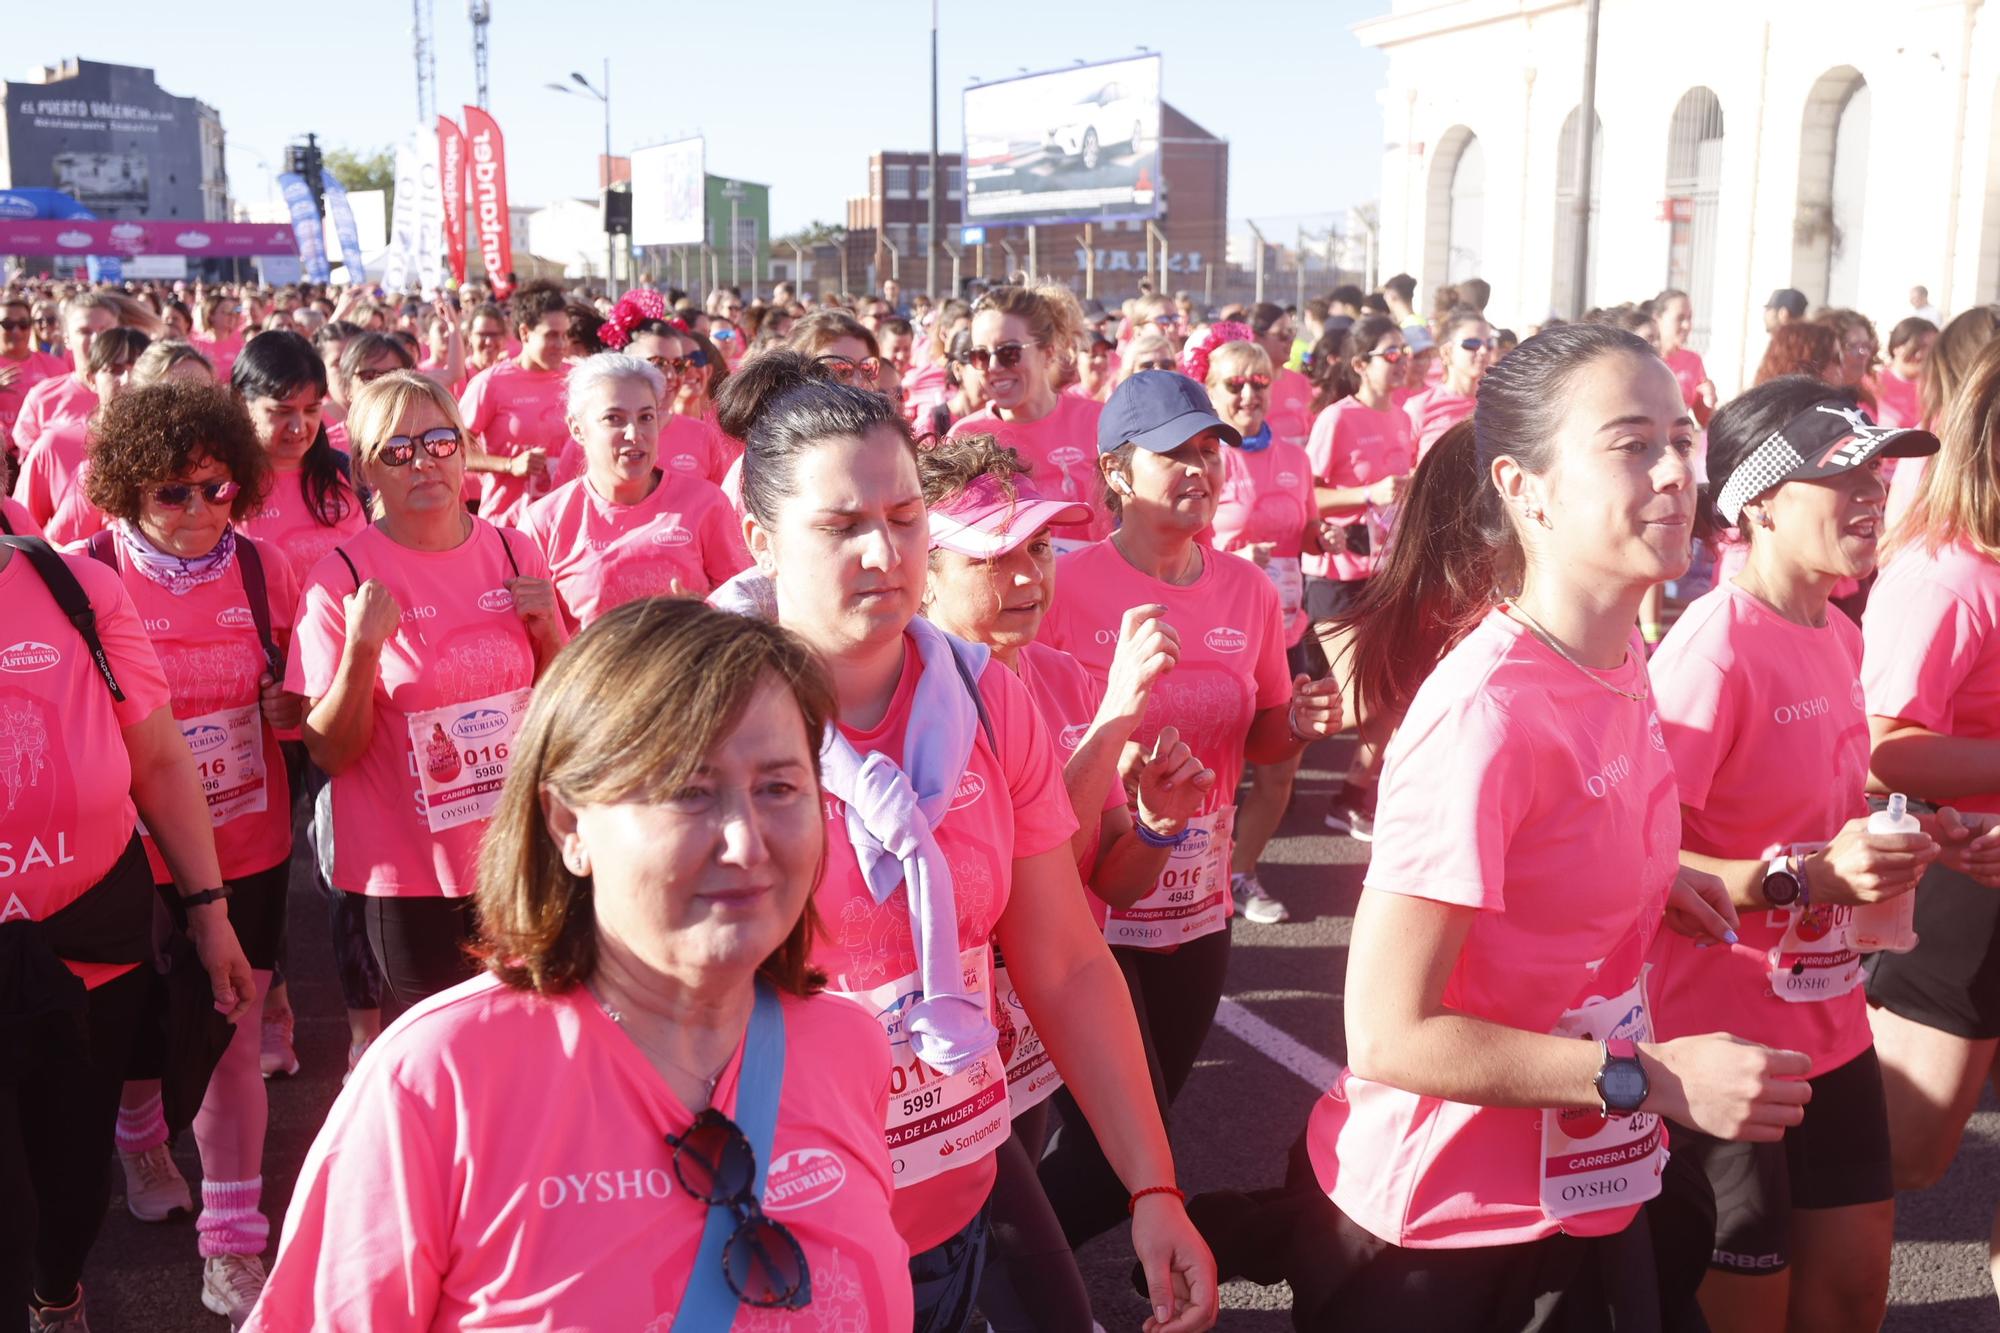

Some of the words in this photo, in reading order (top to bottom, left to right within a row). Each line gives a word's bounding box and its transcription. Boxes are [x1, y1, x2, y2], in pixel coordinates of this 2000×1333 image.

[37, 100, 88, 117] PUERTO
[400, 605, 437, 623] YSHO
[2, 653, 56, 667] ASTURIANA
[1774, 696, 1829, 725] OYSHO
[456, 717, 505, 735] ASTURIANA
[188, 734, 225, 749] TURIANA
[463, 742, 509, 766] 016
[197, 758, 226, 777] 16
[475, 764, 504, 779] 5980
[441, 787, 476, 801] CARRERA
[477, 784, 488, 792] DE
[490, 781, 500, 790] LA
[441, 802, 480, 820] OYSHO
[1168, 890, 1194, 903] 4943
[1119, 927, 1162, 939] OYSHO
[1786, 976, 1831, 990] OYSHO
[889, 1056, 944, 1094] 01
[903, 1086, 942, 1116] 5997
[905, 1126, 921, 1140] DE
[923, 1121, 937, 1133] LA
[940, 1105, 974, 1127] MUJER
[977, 1090, 995, 1110] 2023
[956, 1118, 1001, 1152] Santander
[1569, 1151, 1626, 1170] CARRERA
[1628, 1145, 1642, 1158] DE
[538, 1168, 672, 1209] OYSHO
[764, 1165, 842, 1205] ASTURIANA
[1562, 1177, 1628, 1201] OYSHO
